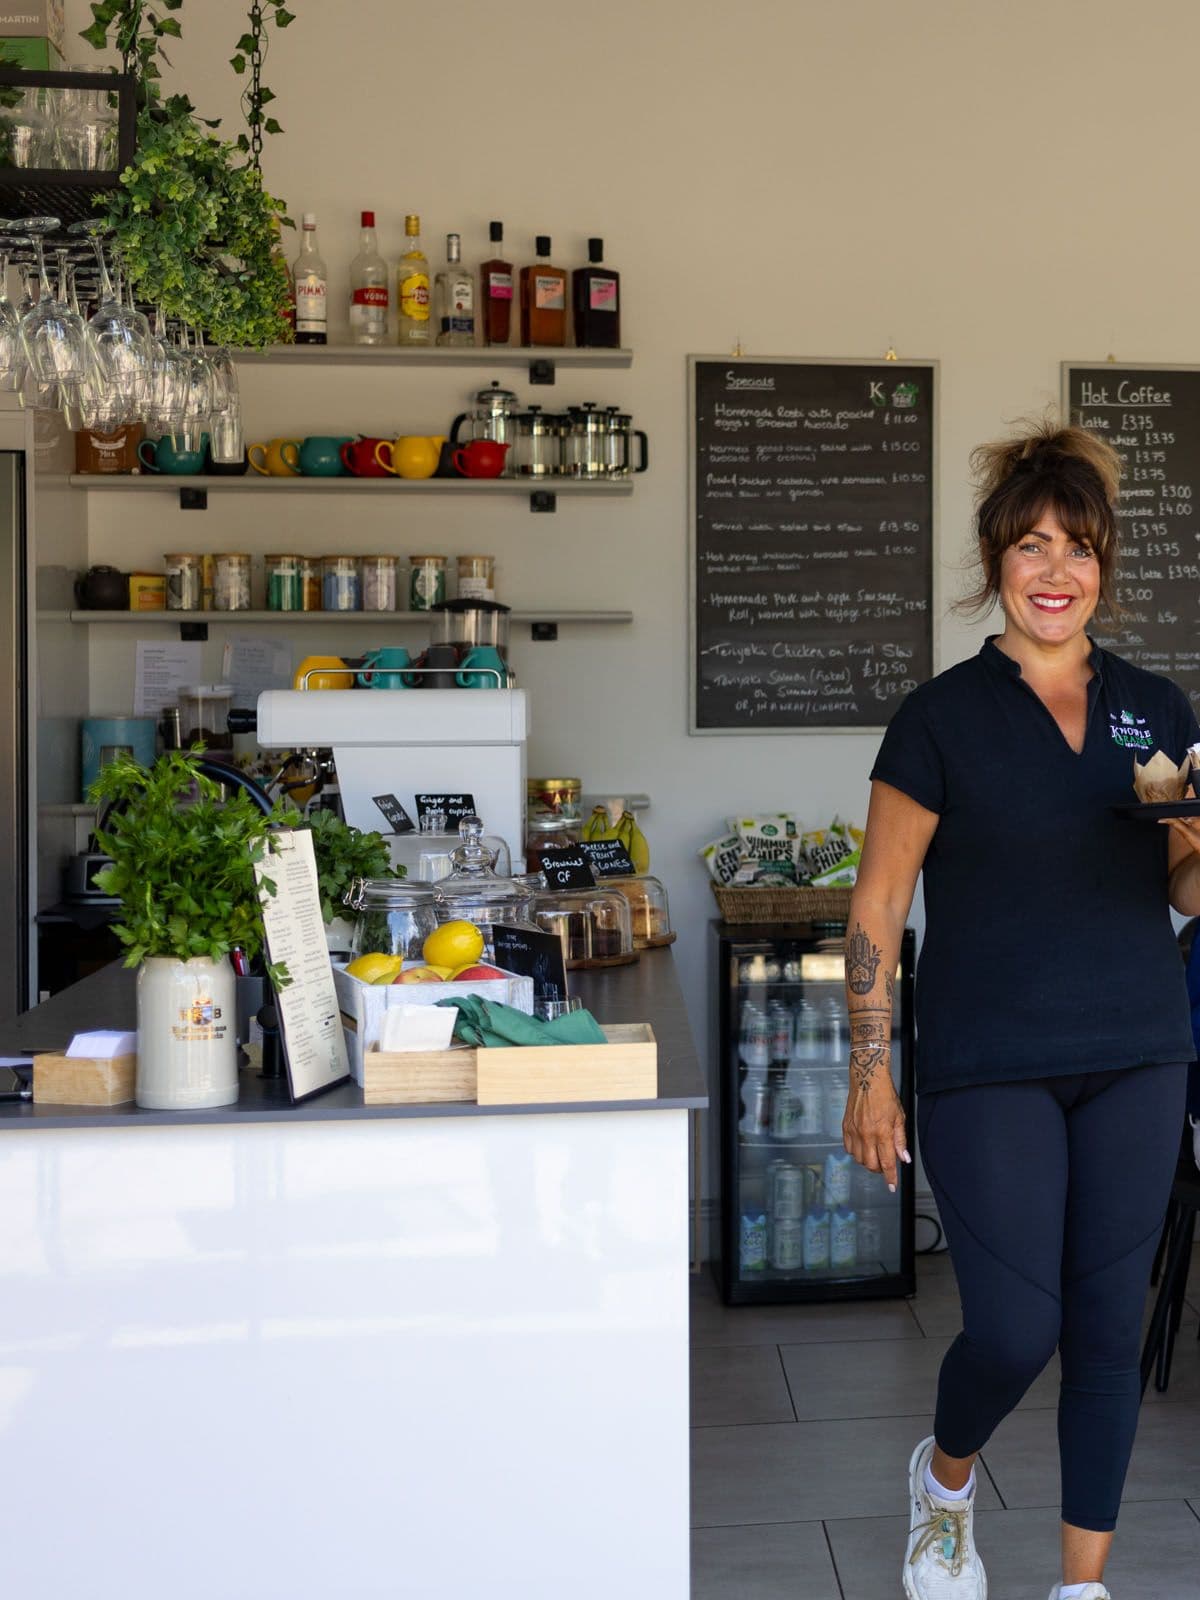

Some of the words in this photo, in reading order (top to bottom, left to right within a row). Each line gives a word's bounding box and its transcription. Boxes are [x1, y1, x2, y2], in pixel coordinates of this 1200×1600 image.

[0, 15, 40, 24] MARTINI
[725, 371, 776, 389] Specials
[1081, 382, 1109, 406] Hot
[1117, 380, 1172, 406] Coffee
[1110, 725, 1151, 739] KNOWLE
